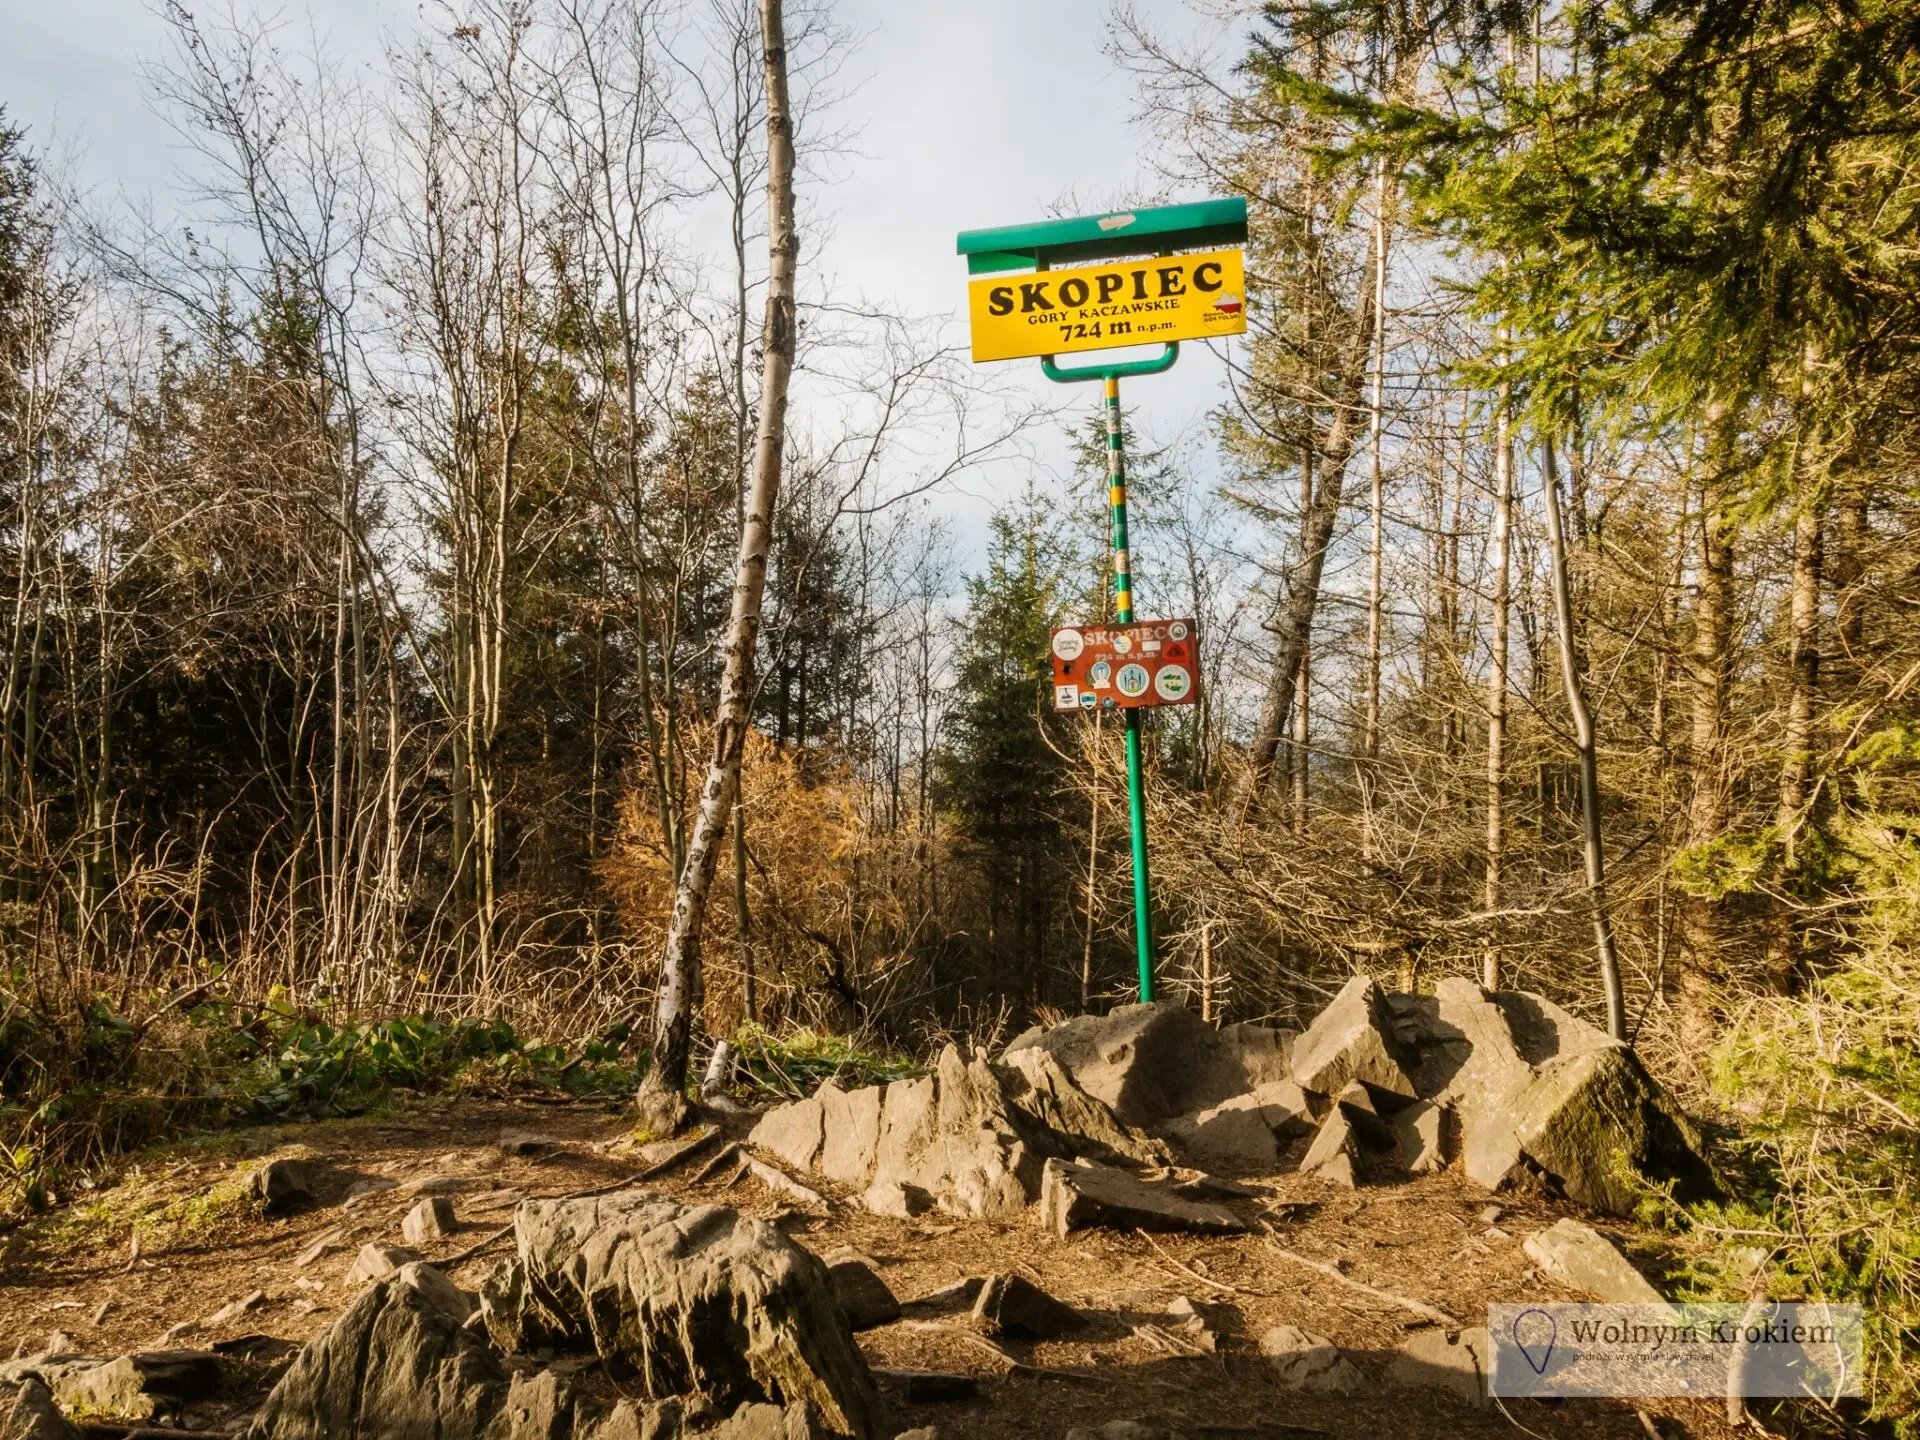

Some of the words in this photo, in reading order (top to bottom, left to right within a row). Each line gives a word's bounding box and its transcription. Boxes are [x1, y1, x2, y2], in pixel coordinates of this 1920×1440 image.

[988, 262, 1223, 316] SKOPIEC
[1028, 310, 1068, 325] GÓRY
[1079, 298, 1180, 319] KACZAWSKIE
[1060, 321, 1102, 342] 724
[1110, 320, 1132, 335] m
[1137, 321, 1176, 335] n.p.m.
